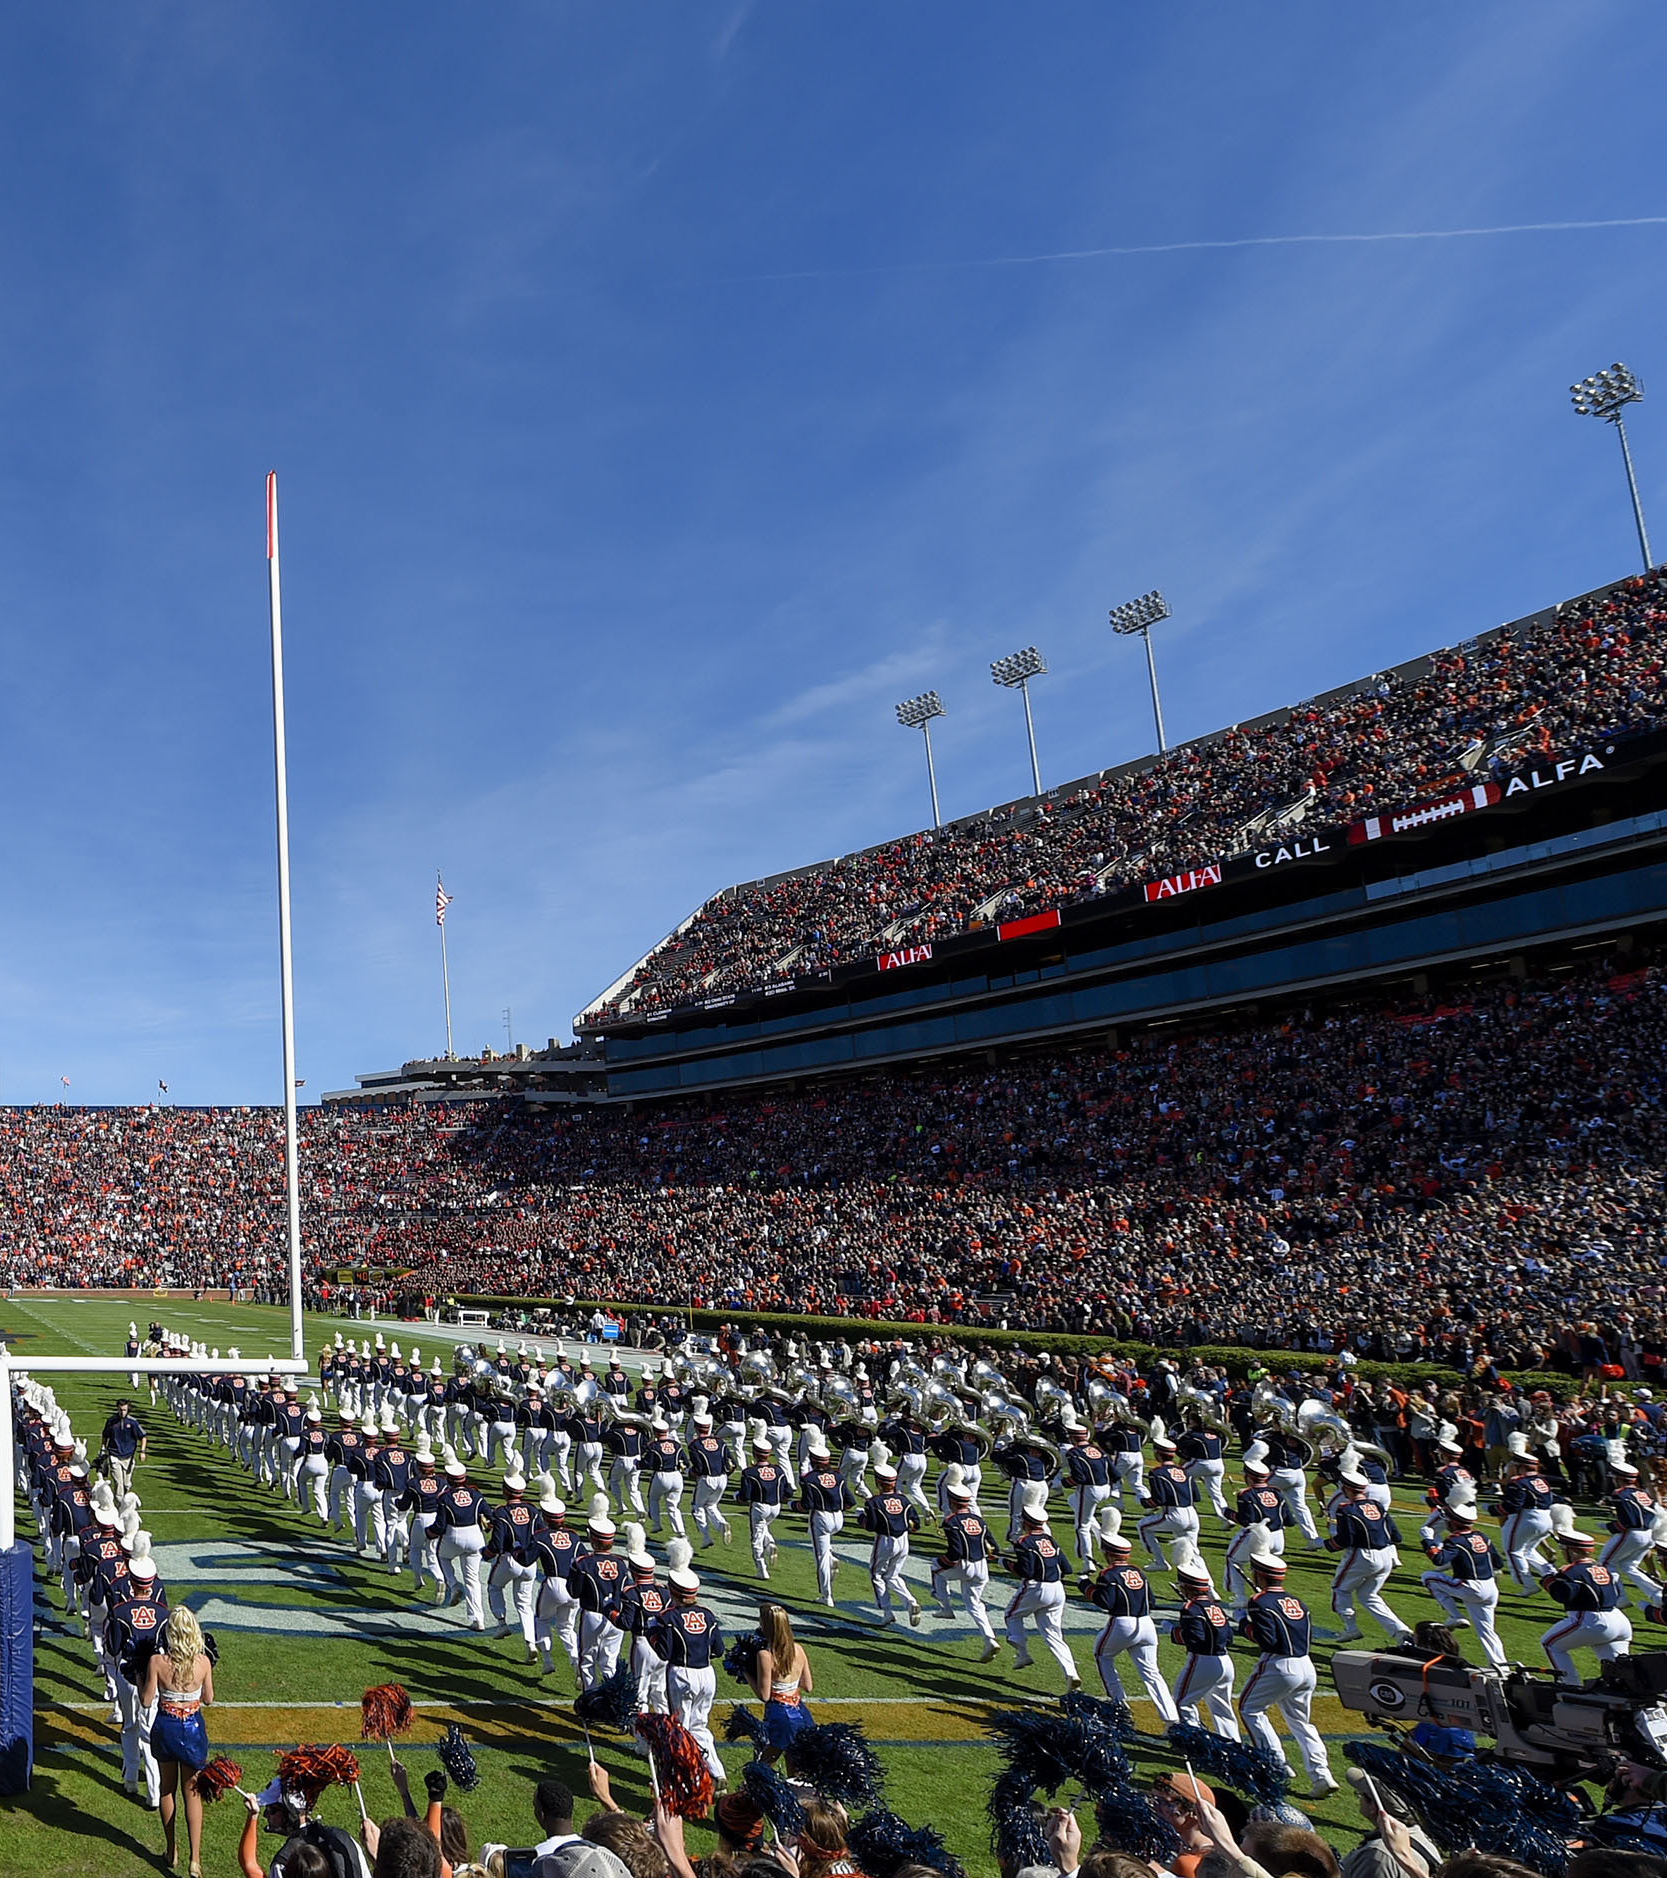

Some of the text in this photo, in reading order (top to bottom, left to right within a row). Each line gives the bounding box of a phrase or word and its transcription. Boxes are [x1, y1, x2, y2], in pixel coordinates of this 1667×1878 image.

[1505, 753, 1604, 797] ALFA
[1254, 837, 1330, 868] CALL
[1156, 865, 1220, 899] ALFA
[886, 945, 931, 969] ALFA
